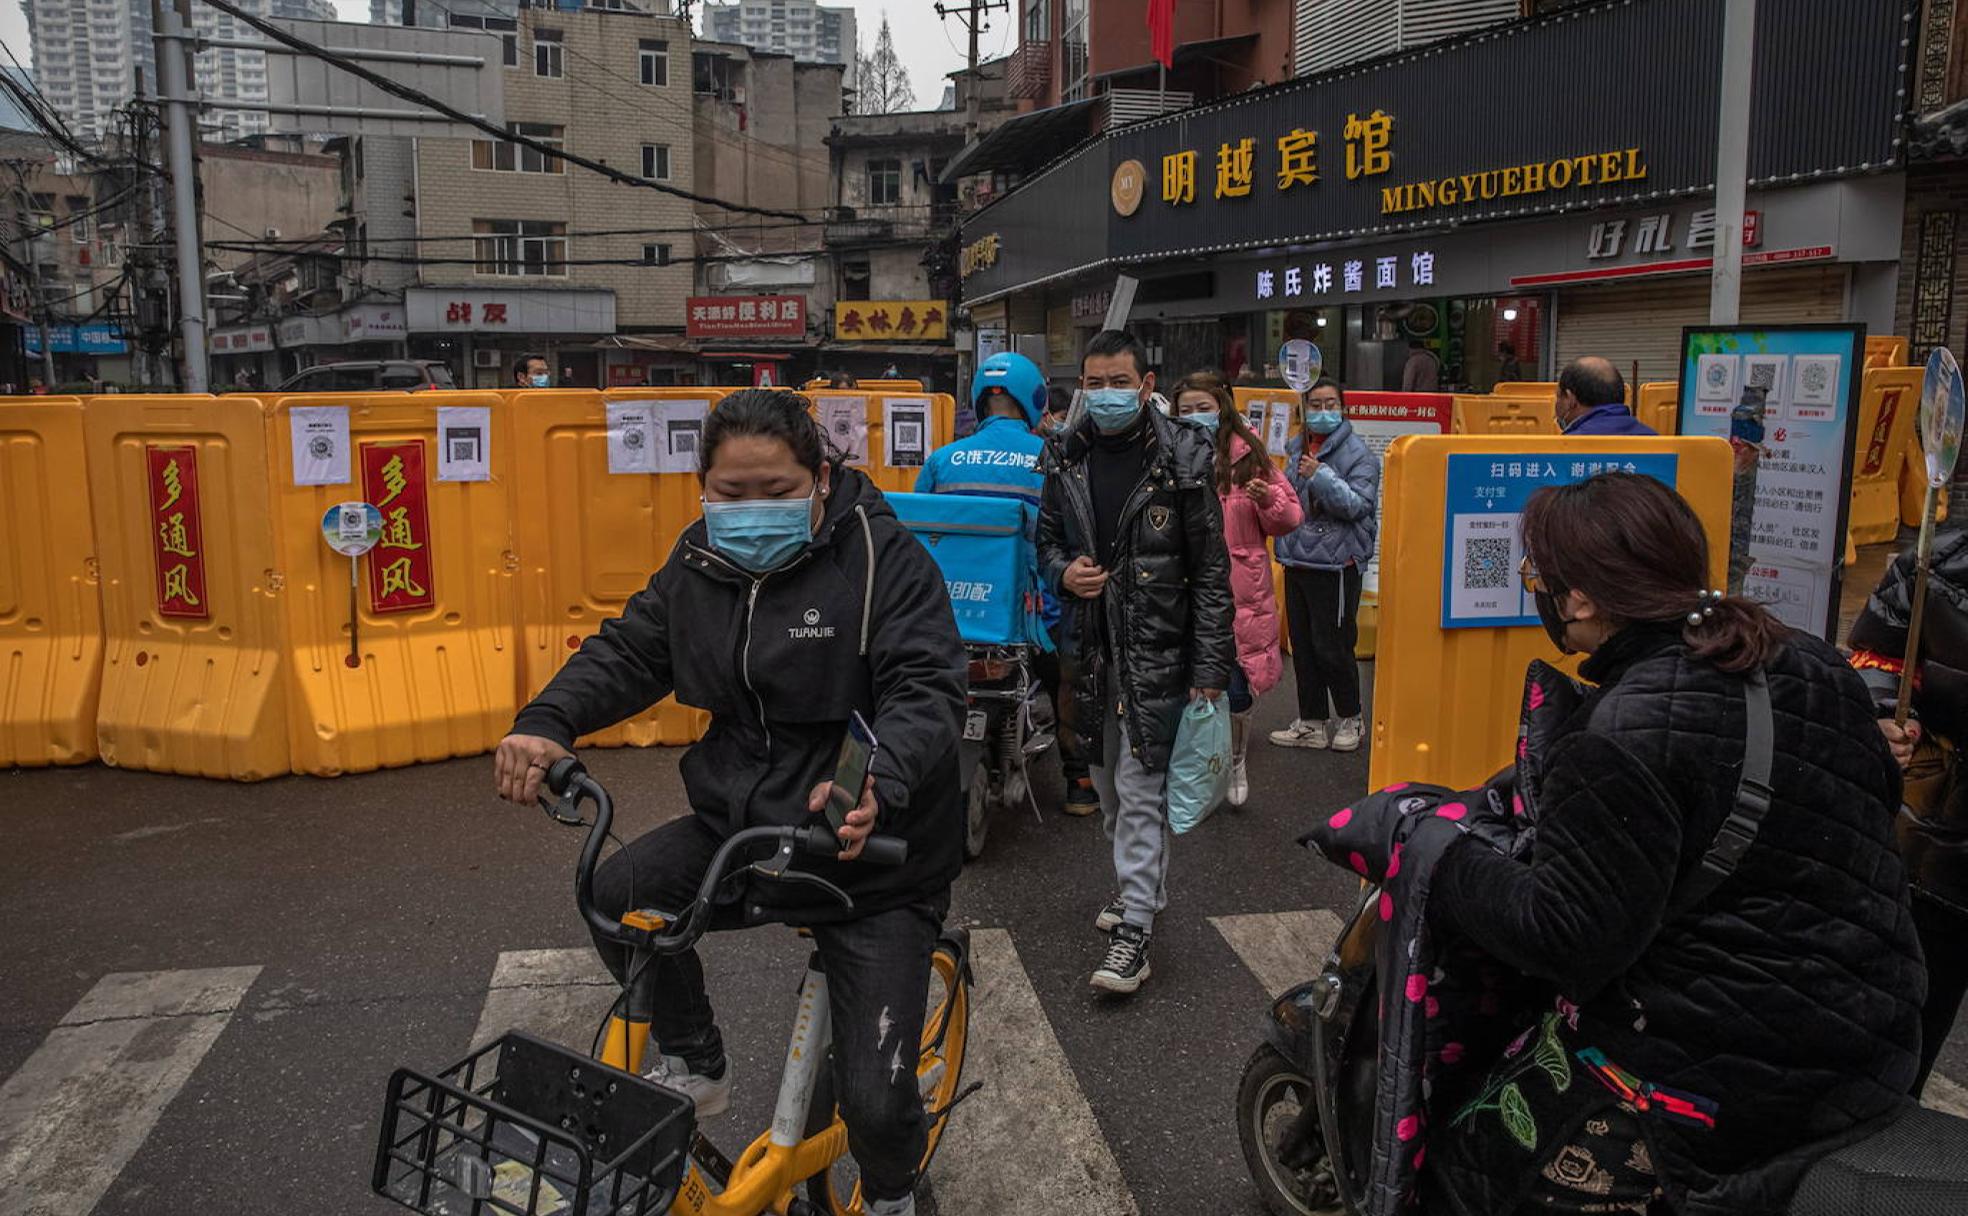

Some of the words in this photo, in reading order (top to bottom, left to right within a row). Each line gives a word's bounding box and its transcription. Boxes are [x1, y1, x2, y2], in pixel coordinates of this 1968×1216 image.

[1161, 110, 1394, 206] 明越宾馆
[1381, 148, 1647, 214] MINGYUEHOTEL
[1256, 251, 1436, 300] 陈氏炸酱面馆
[1490, 462, 1557, 478] 扫码进入
[1474, 486, 1507, 499] 支付宝
[159, 457, 200, 607] 多通风
[945, 580, 993, 602] 即配
[788, 627, 835, 638] TUANJIE
